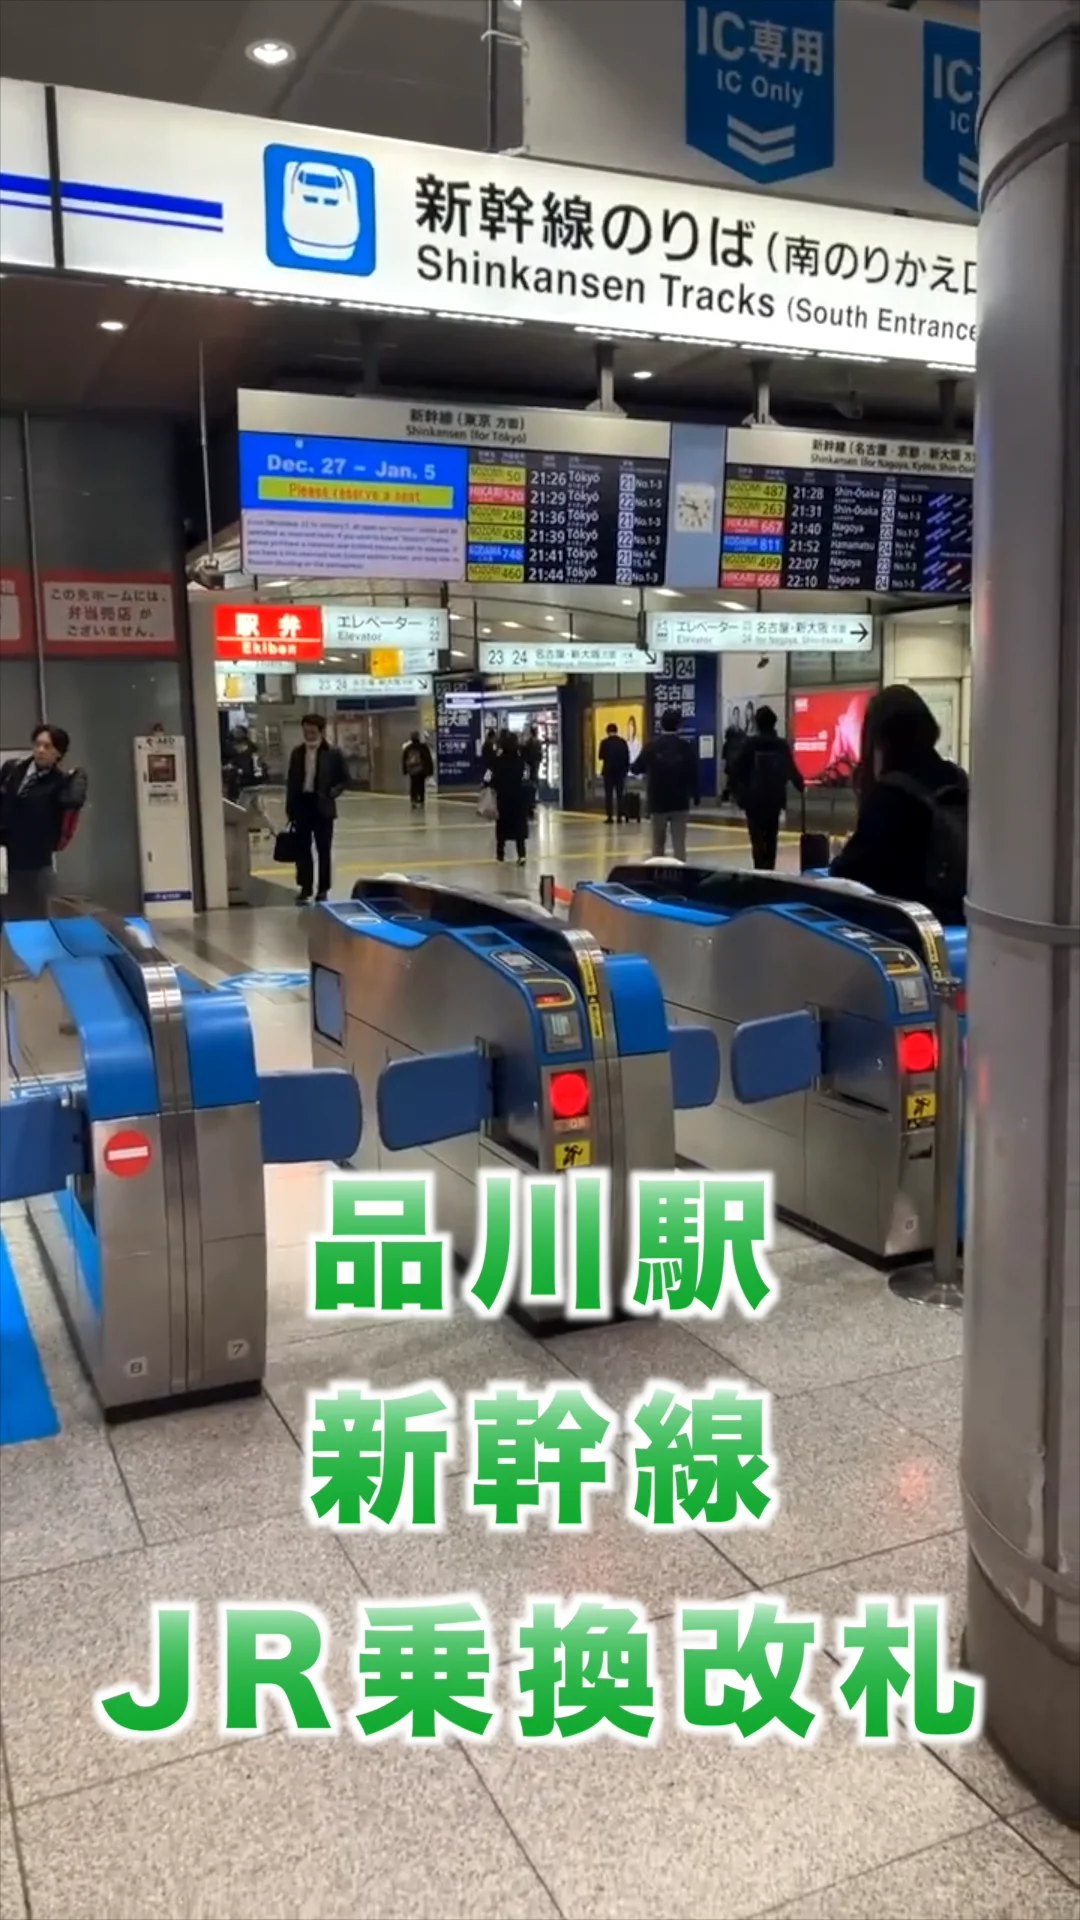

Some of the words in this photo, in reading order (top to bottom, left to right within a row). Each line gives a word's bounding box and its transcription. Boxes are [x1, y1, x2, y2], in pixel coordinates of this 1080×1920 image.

[697, 6, 824, 77] IC専用
[716, 69, 742, 94] IC
[751, 76, 804, 109] Only
[417, 244, 646, 304] Shinkansen
[659, 273, 775, 318] Tracks
[787, 296, 868, 329] (South
[266, 454, 315, 473] Dec.
[320, 457, 347, 475] 27
[374, 460, 418, 480] Jan.
[423, 463, 437, 481] 5
[506, 472, 521, 482] 50
[530, 470, 567, 486] 21:26
[622, 475, 634, 491] 21
[288, 483, 328, 498] Please
[762, 485, 784, 496] 487
[792, 486, 825, 500] 21:28
[530, 490, 567, 505] 21:29
[620, 494, 634, 509] 22
[762, 503, 783, 515] 263
[791, 504, 822, 518] 21:31
[503, 509, 522, 521] 248
[529, 510, 566, 524] 21:36
[620, 513, 633, 529] 21
[760, 520, 782, 533] 667
[790, 522, 822, 535] 21:40
[502, 529, 522, 541] 458
[529, 530, 565, 543] 21:39
[619, 532, 633, 547] 22
[759, 538, 780, 550] 811
[788, 539, 820, 553] 21:52
[529, 548, 563, 562] 21:41
[618, 550, 632, 566] 21
[758, 556, 779, 568] 499
[787, 557, 819, 570] 22:07
[528, 567, 563, 581] 21:44
[617, 568, 632, 585] 22
[786, 575, 818, 589] 22:10
[235, 613, 302, 638] 駅弁
[337, 615, 422, 630] エレベーター
[677, 621, 739, 633] エレベーター
[338, 630, 383, 642] Elevator
[242, 642, 297, 655] Ekiben
[488, 649, 504, 665] 23
[512, 649, 528, 665] 24
[680, 659, 695, 676] 24
[654, 684, 695, 701] 名古屋
[232, 1342, 243, 1355] 7
